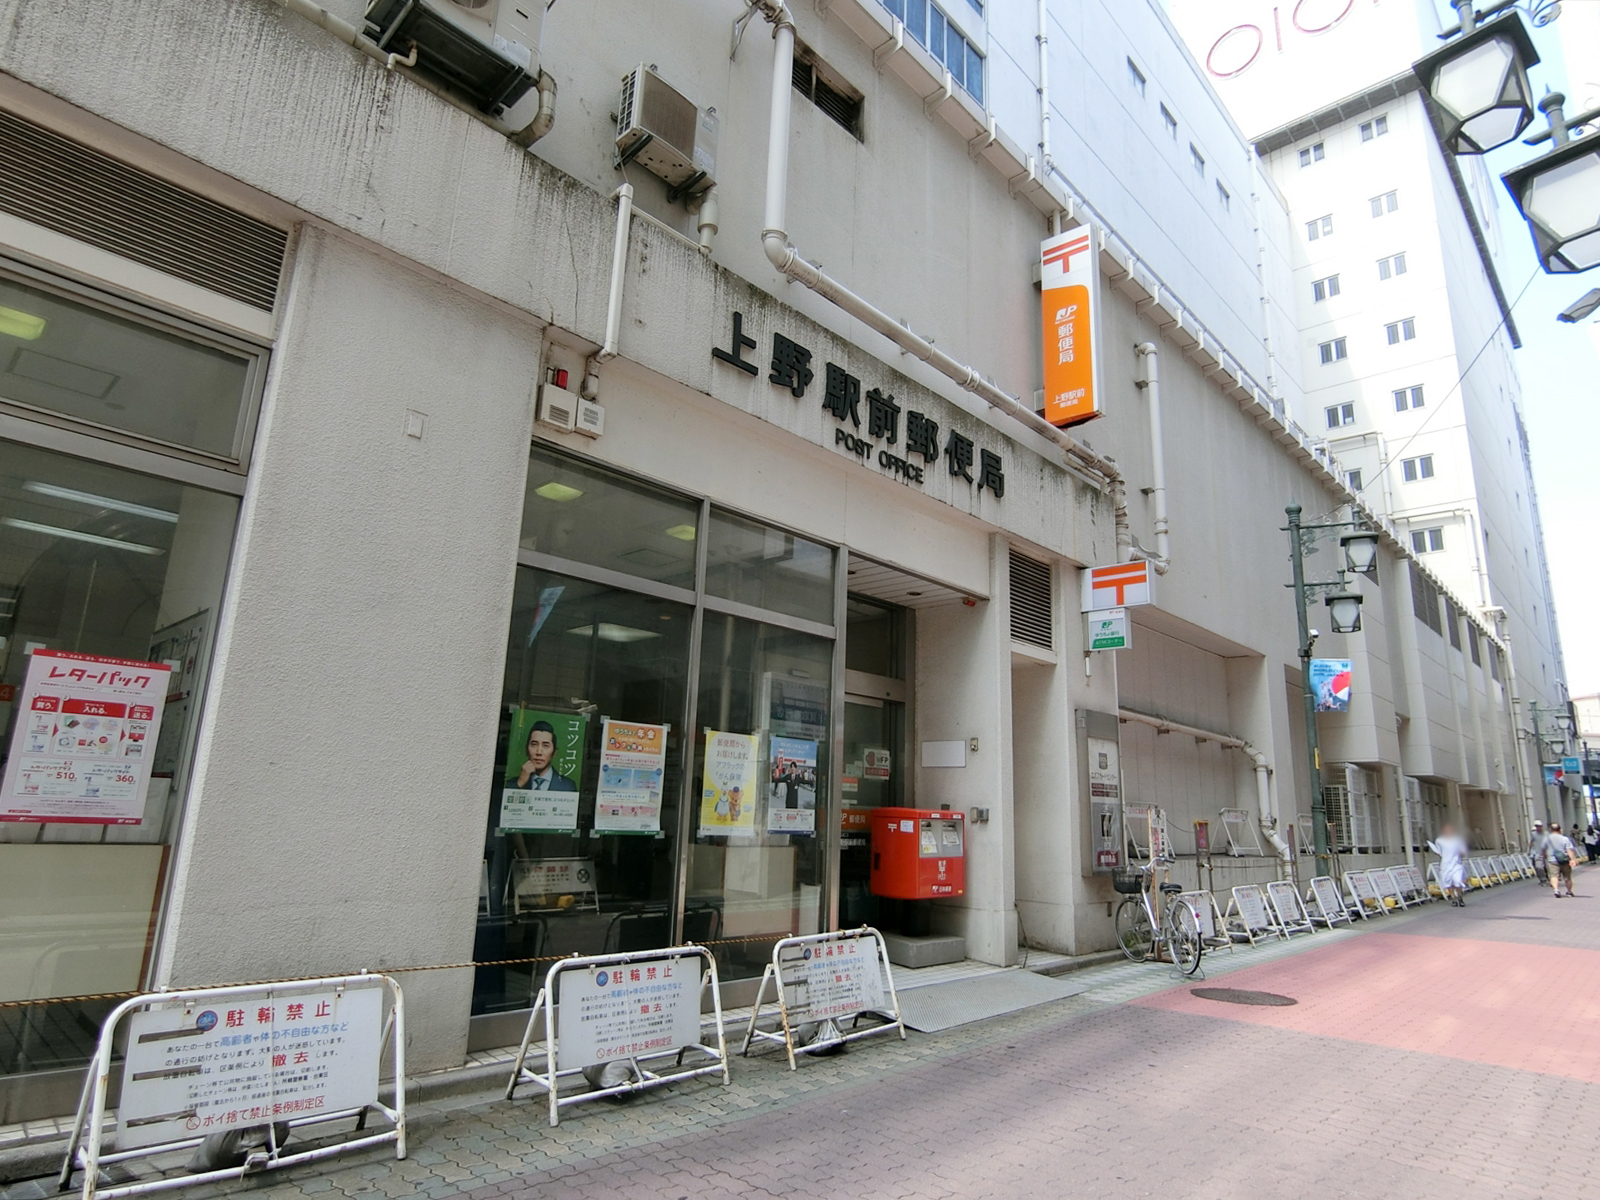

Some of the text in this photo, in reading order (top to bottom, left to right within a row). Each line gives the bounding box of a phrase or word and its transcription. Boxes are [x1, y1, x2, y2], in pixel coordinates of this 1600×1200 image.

[1057, 322, 1074, 366] 郵便局
[712, 311, 1005, 499] 上野駅前郵便局
[1053, 388, 1085, 405] 上野駅前
[1059, 398, 1079, 409] 郵便局
[835, 428, 924, 485] POST OFFICE
[48, 666, 151, 689] レターパック
[83, 706, 108, 715] 入れる。
[564, 721, 579, 776] コツコツ
[717, 738, 746, 749] 郵便局から
[716, 750, 749, 760] お届けします。
[56, 772, 75, 780] 510
[116, 775, 134, 783] 360
[612, 965, 672, 985] 駐輪禁止
[225, 1000, 332, 1028] 駐輪禁止
[640, 1003, 662, 1014] 撤去
[272, 1051, 309, 1067] 撤去
[202, 1095, 326, 1127] ポイ捨て禁止条例制定区
